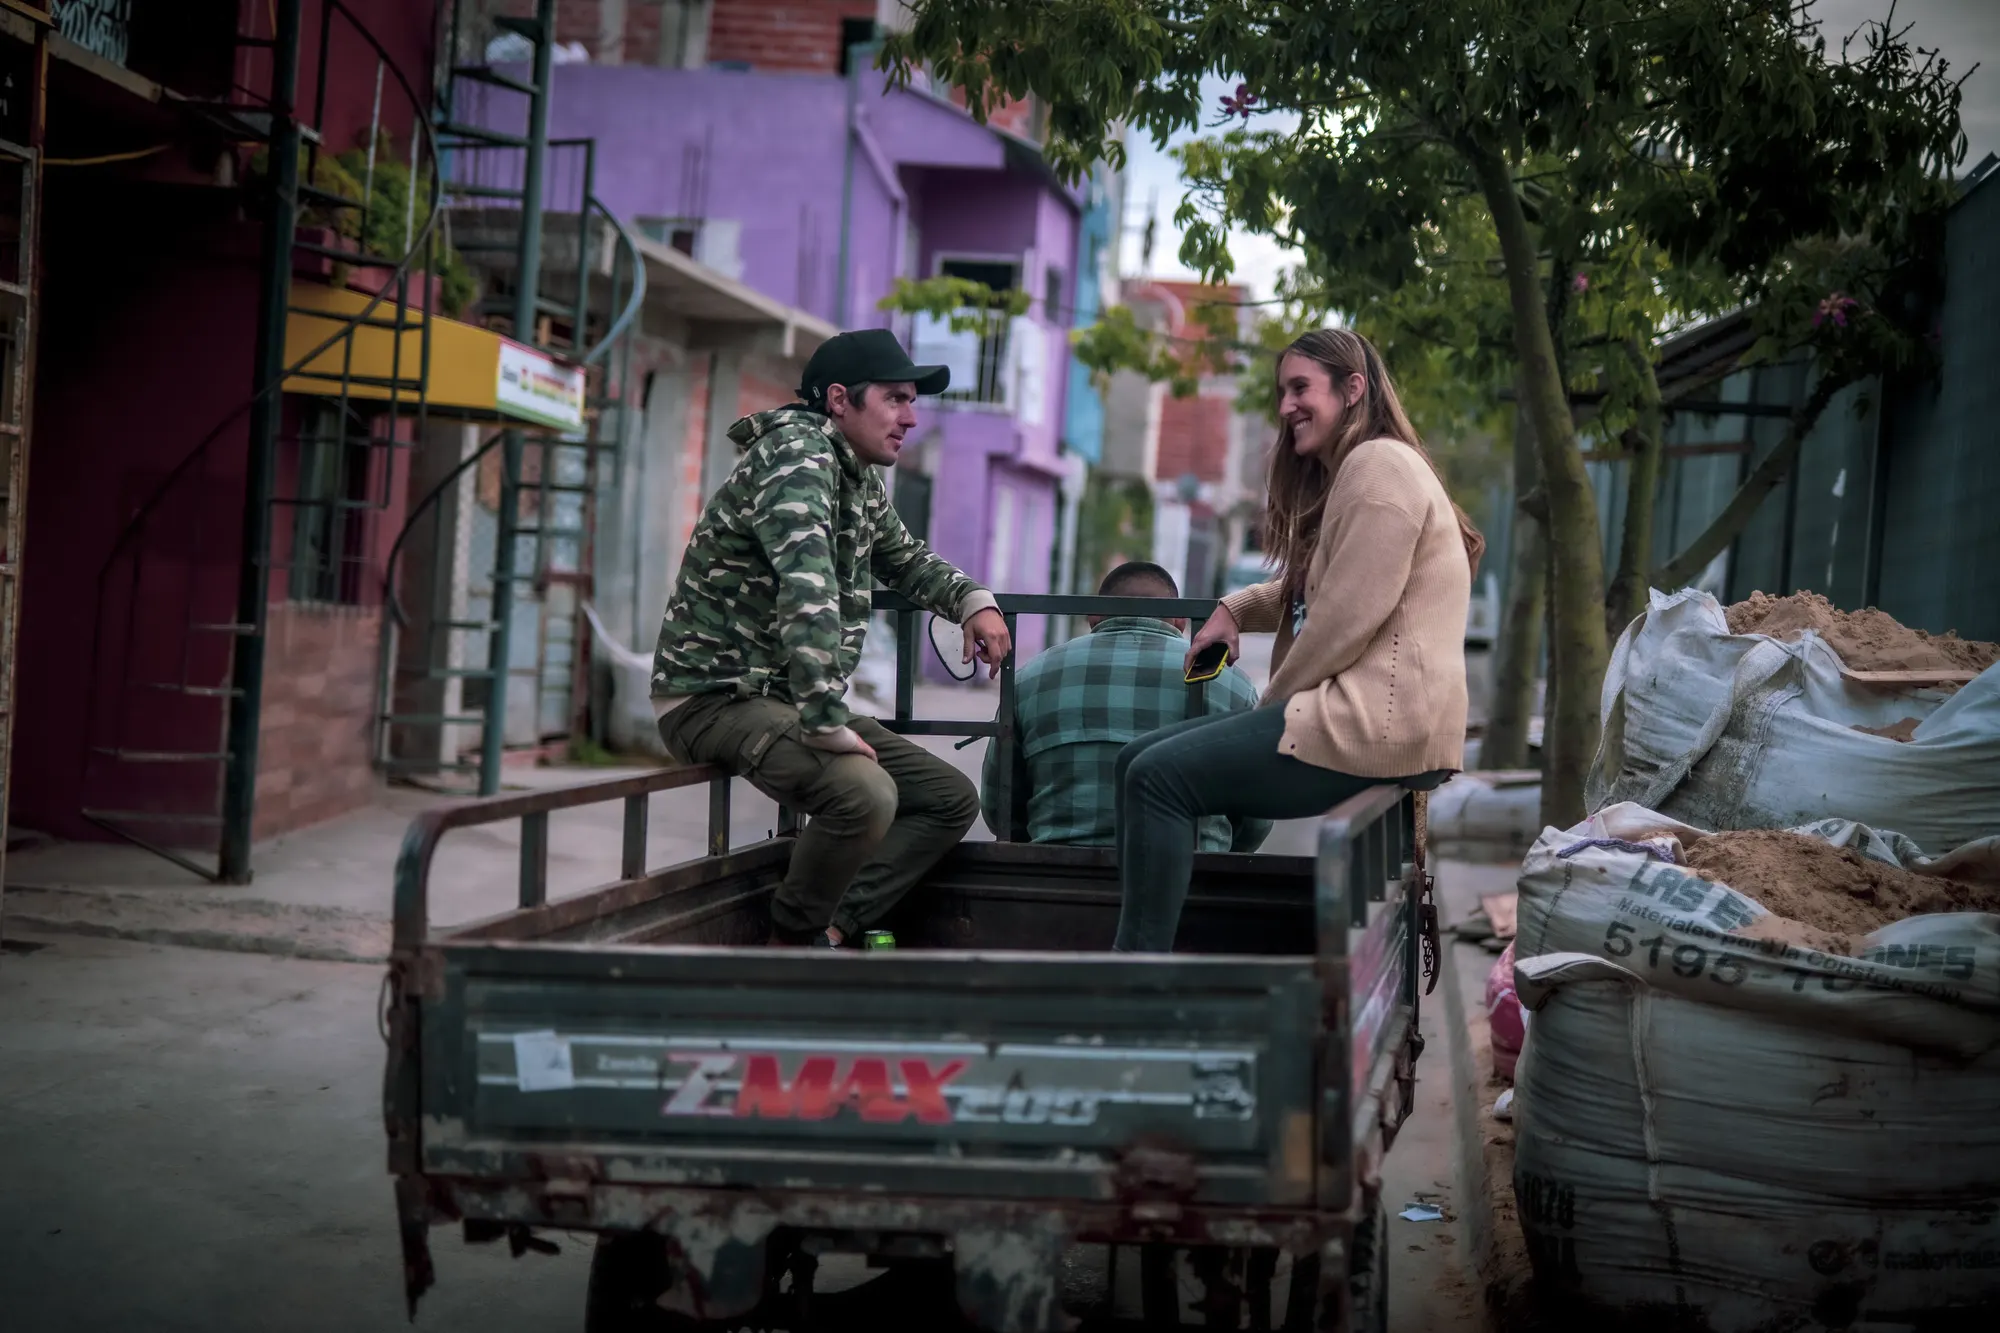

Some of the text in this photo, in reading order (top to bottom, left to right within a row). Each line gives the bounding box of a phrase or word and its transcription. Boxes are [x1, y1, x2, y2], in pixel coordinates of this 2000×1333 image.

[1629, 859, 1714, 912] LAS
[1617, 897, 1715, 939] Materiales
[662, 1052, 968, 1122] ZMAX
